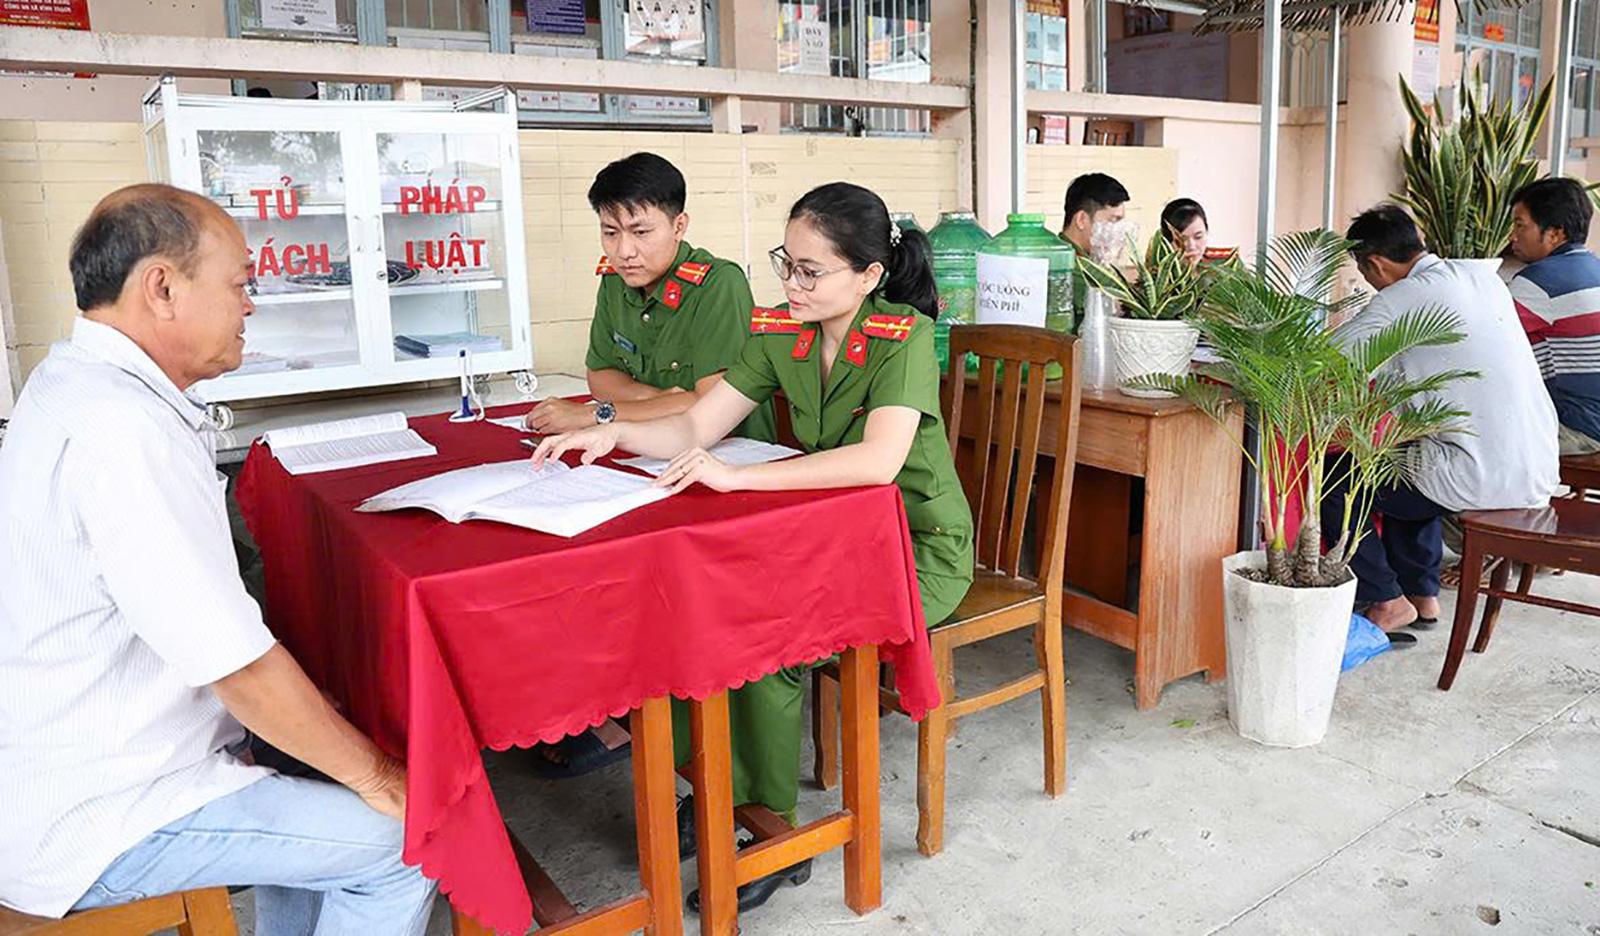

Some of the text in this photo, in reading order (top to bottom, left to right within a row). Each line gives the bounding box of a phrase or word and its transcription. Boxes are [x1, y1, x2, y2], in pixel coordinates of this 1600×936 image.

[250, 175, 299, 221] TỦ
[400, 178, 486, 215] PHÁP
[405, 232, 486, 275] LUẬT
